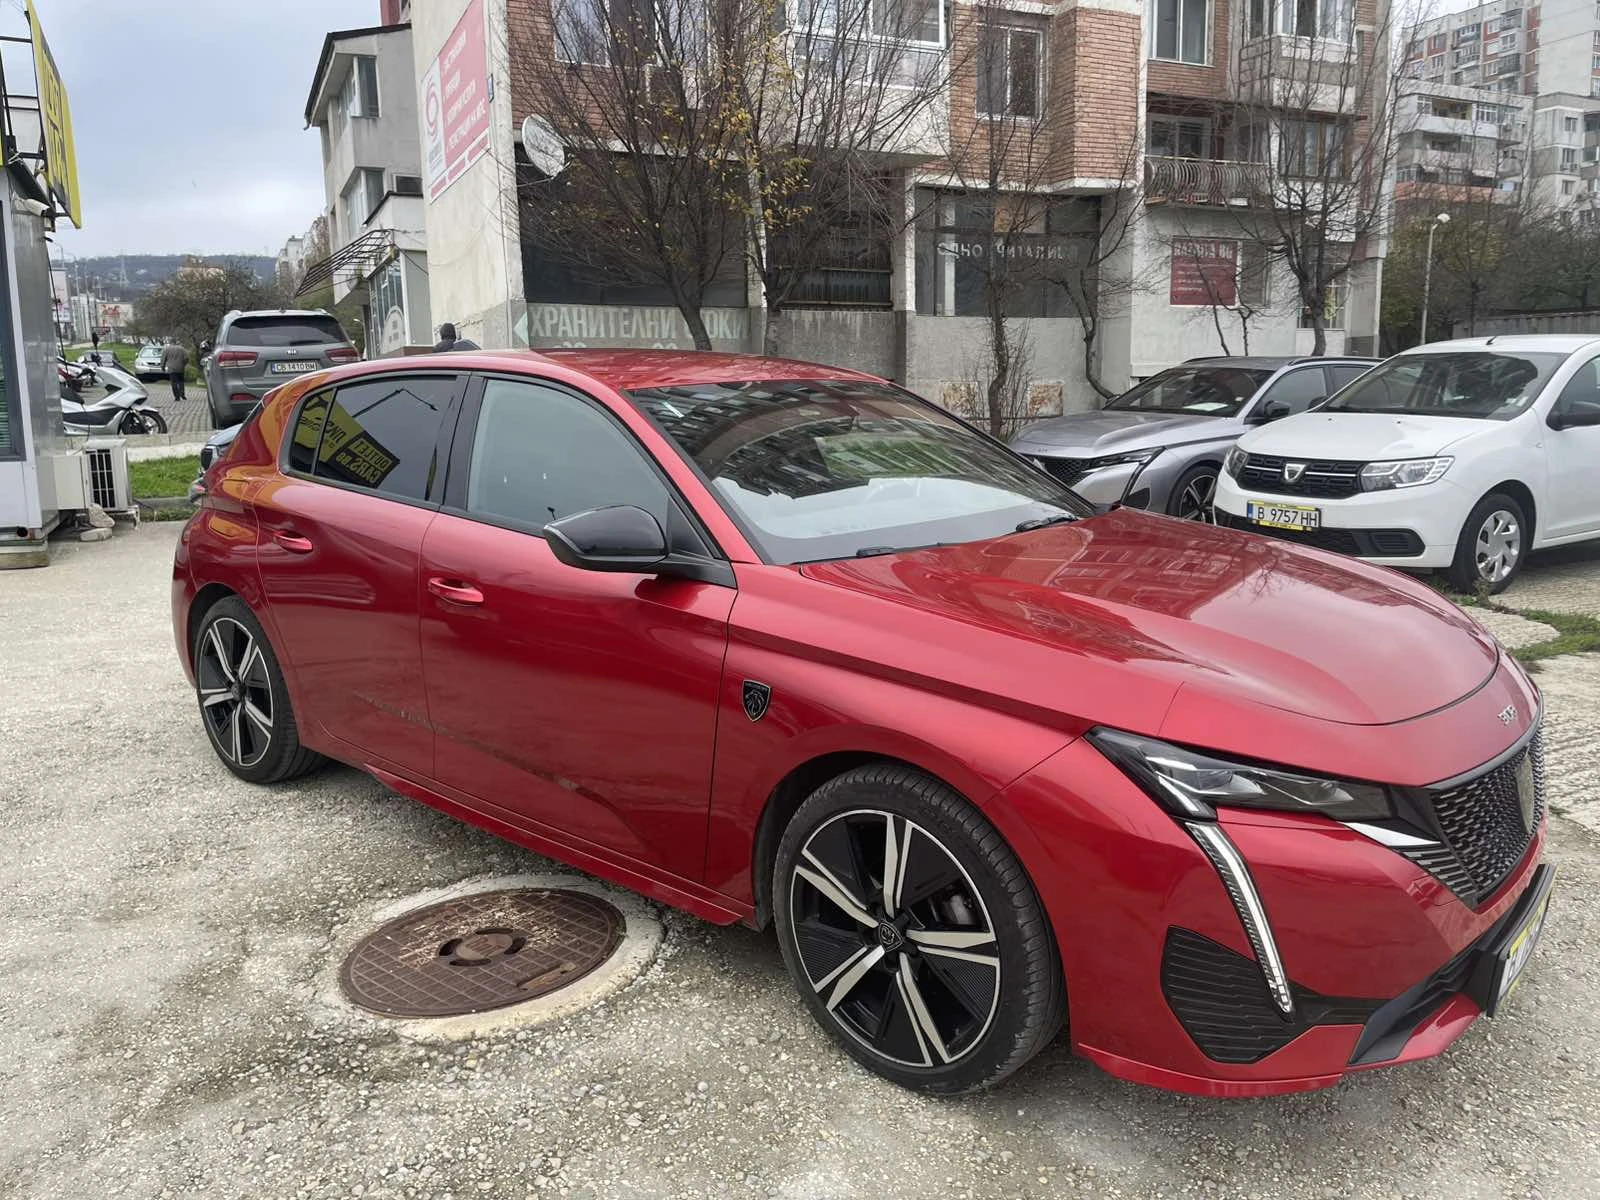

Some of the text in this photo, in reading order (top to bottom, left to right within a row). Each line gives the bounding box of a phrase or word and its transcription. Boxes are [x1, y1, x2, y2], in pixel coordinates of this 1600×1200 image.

[530, 306, 678, 339] ХРАНИТЕЛНИ
[1270, 508, 1299, 524] 9757
[1300, 511, 1318, 526] HH
